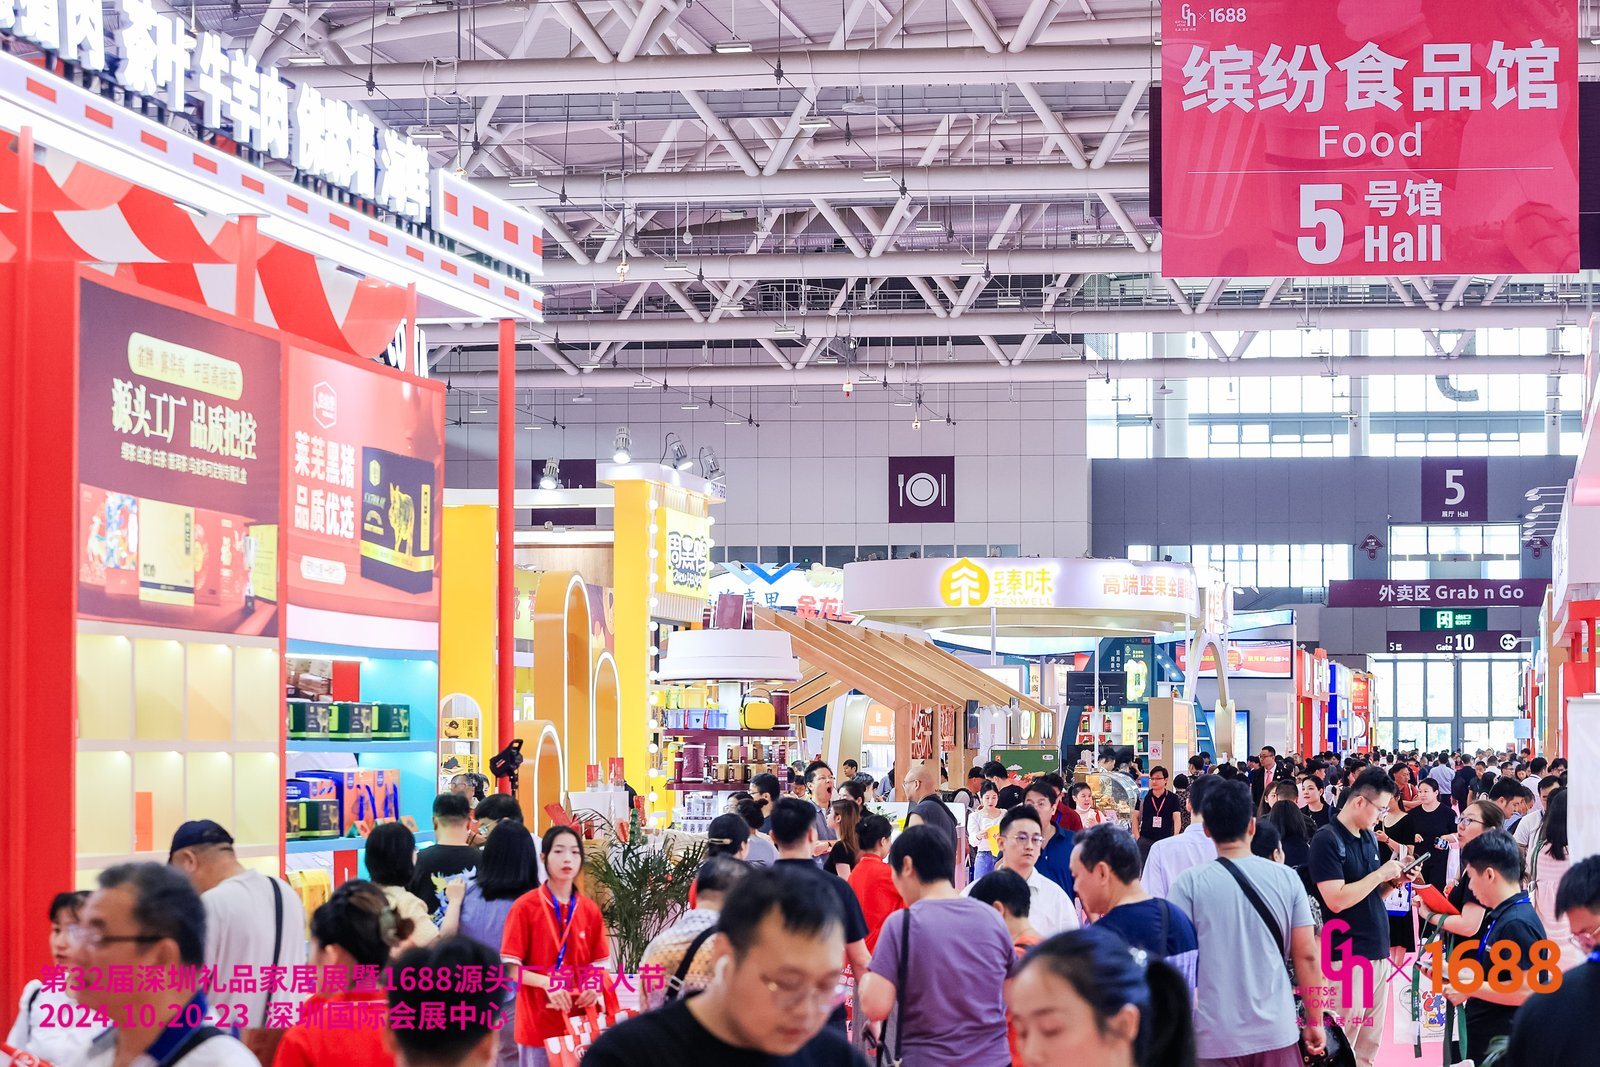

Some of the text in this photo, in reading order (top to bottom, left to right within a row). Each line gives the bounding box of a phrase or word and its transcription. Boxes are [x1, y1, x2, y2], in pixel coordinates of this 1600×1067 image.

[1208, 7, 1247, 23] 1688
[1181, 39, 1560, 114] 缤纷食品馆
[0, 0, 104, 70] 猪肉
[119, 0, 190, 112] 茶叶
[199, 31, 288, 158] 牛羊肉
[381, 128, 429, 222] 海鲜
[1318, 122, 1423, 158] Food
[1297, 178, 1443, 265] 5 号馆
[1364, 224, 1442, 262] Hall
[111, 377, 188, 444] 源头工厂
[190, 398, 257, 460] 品质把控
[294, 430, 355, 489] 莱芜黑猪
[1444, 469, 1466, 505] 5
[294, 484, 354, 539] 品质优选
[1457, 510, 1469, 518] Hall
[668, 531, 707, 577] 周黑鸭
[993, 568, 1054, 596] 臻味
[1379, 584, 1524, 602] 外卖区 Grab n Go
[993, 597, 1053, 606] ZENWELL
[1436, 643, 1453, 651] Gate
[1455, 633, 1475, 651] 10
